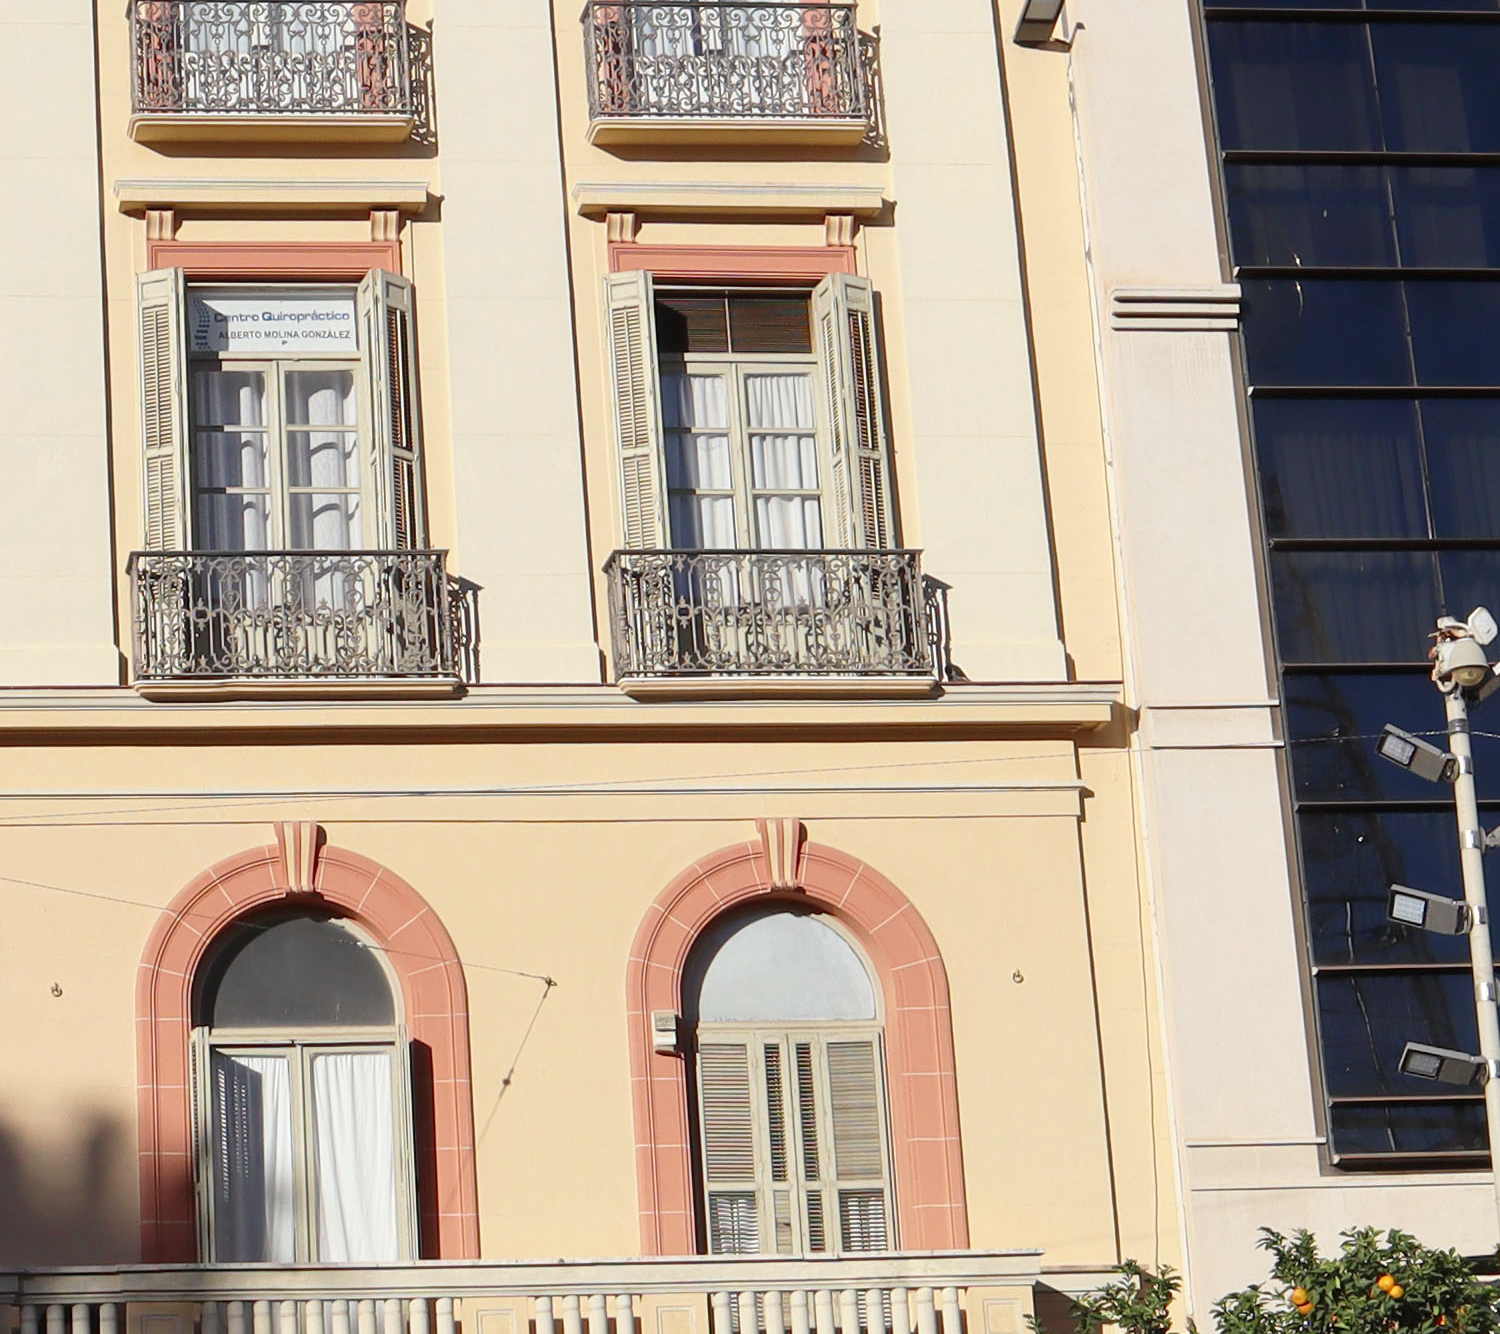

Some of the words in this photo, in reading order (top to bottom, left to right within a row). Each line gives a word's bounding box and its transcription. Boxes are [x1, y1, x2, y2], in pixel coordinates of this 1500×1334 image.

[215, 313, 259, 322] Centro
[262, 311, 350, 323] Quiropráctico
[219, 331, 262, 339] ALBERTO
[265, 330, 299, 339] MOLINA
[302, 329, 351, 339] GONZÁLEZ
